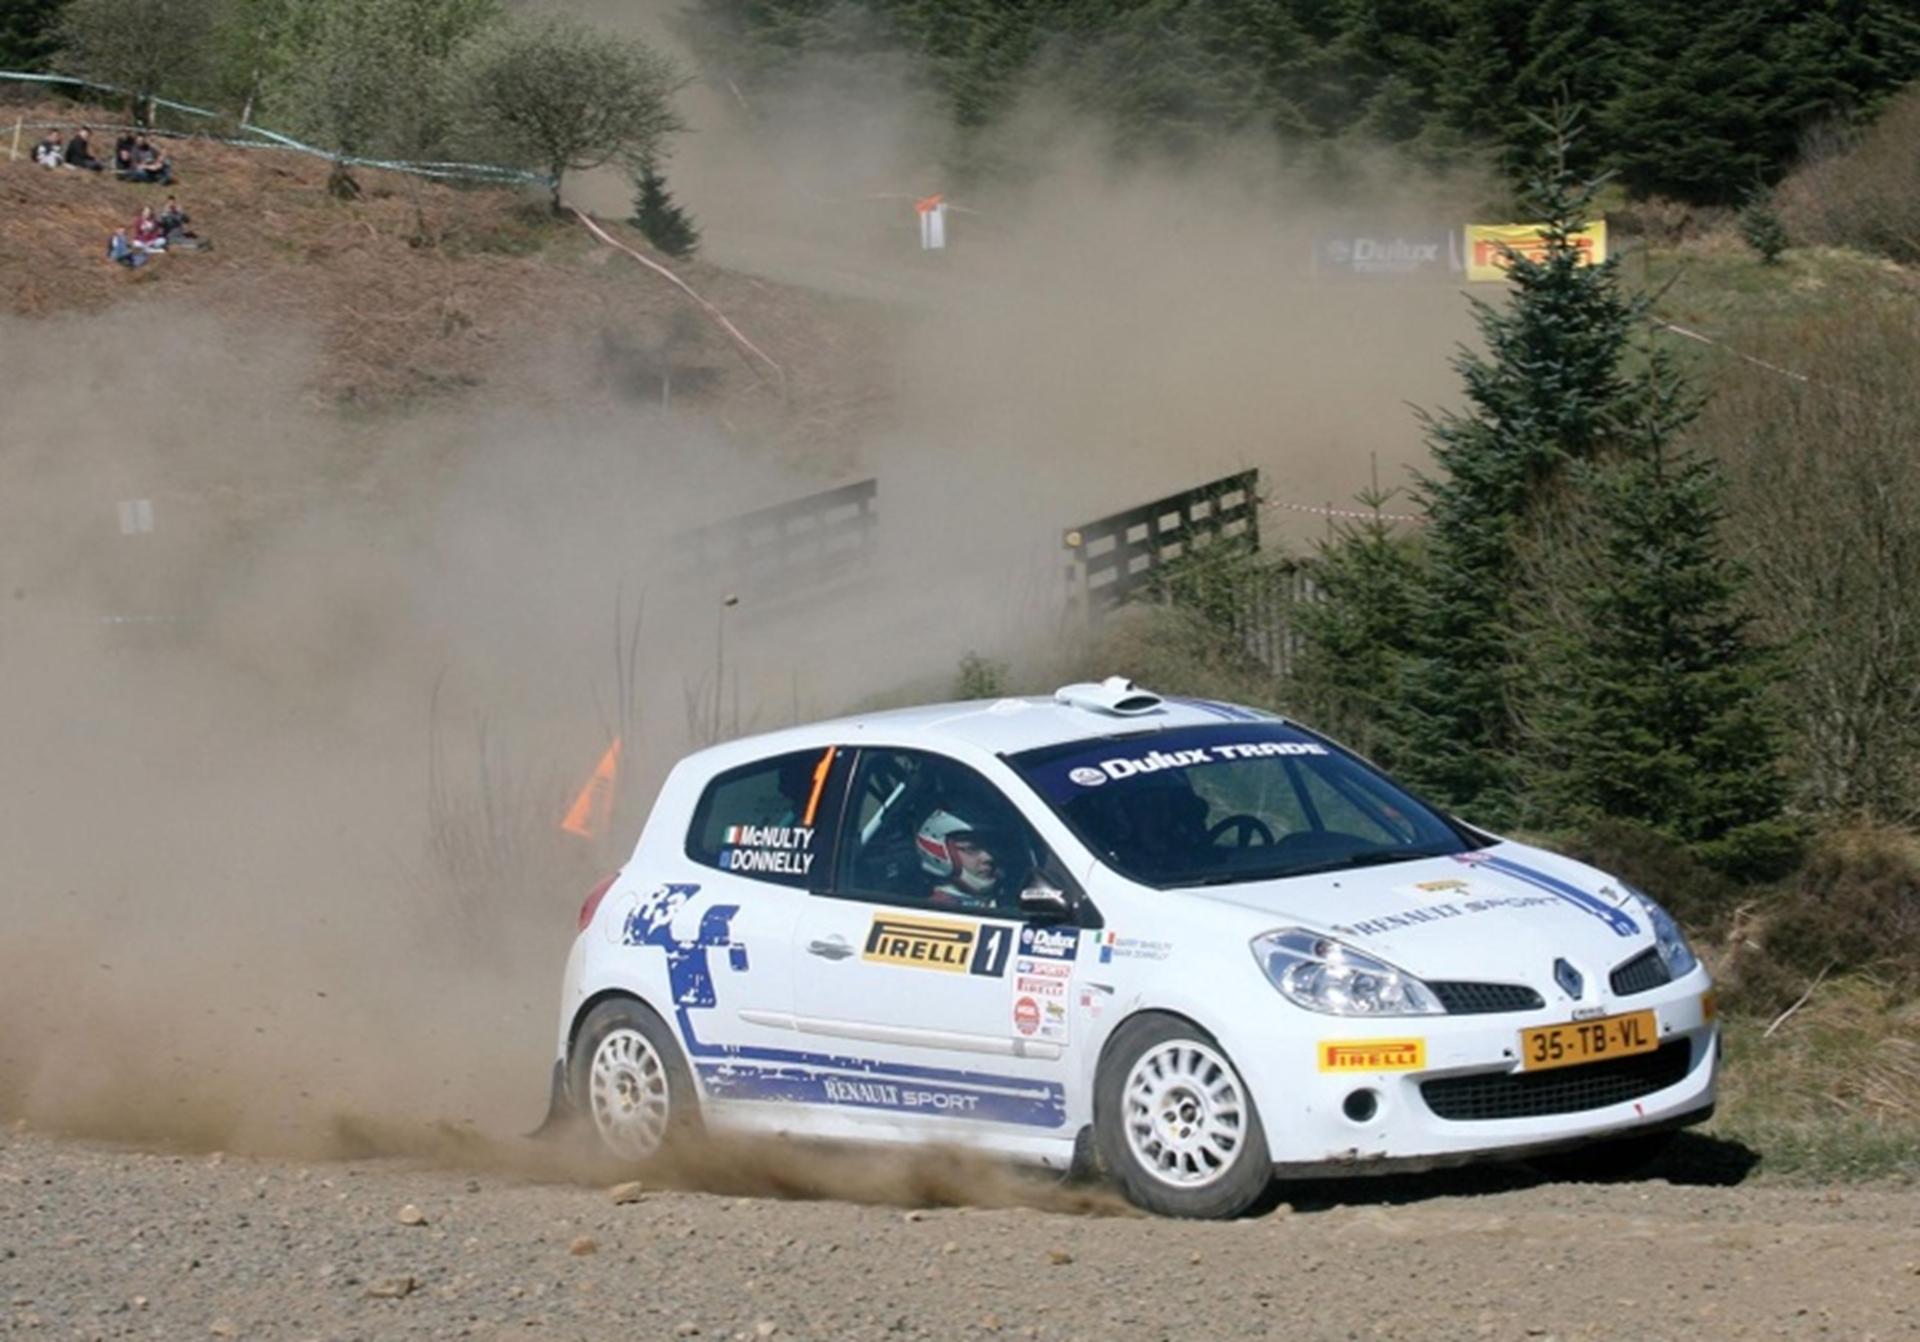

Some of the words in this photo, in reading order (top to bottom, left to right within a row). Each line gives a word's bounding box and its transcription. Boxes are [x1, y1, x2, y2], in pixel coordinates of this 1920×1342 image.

[1100, 750, 1213, 780] Dulux
[1211, 743, 1329, 760] TRADE
[741, 825, 815, 850] McNULTY
[731, 849, 815, 874] DONNELLY
[1353, 902, 1461, 937] RENAULT
[865, 921, 973, 965] PIRELLI
[985, 929, 1003, 972] 1
[1033, 929, 1076, 950] Dulux
[1327, 1043, 1417, 1066] PIRELLI
[1532, 1018, 1647, 1062] 35-TB-VL
[823, 1078, 899, 1106] RENAULT
[901, 1090, 980, 1111] SPORT
